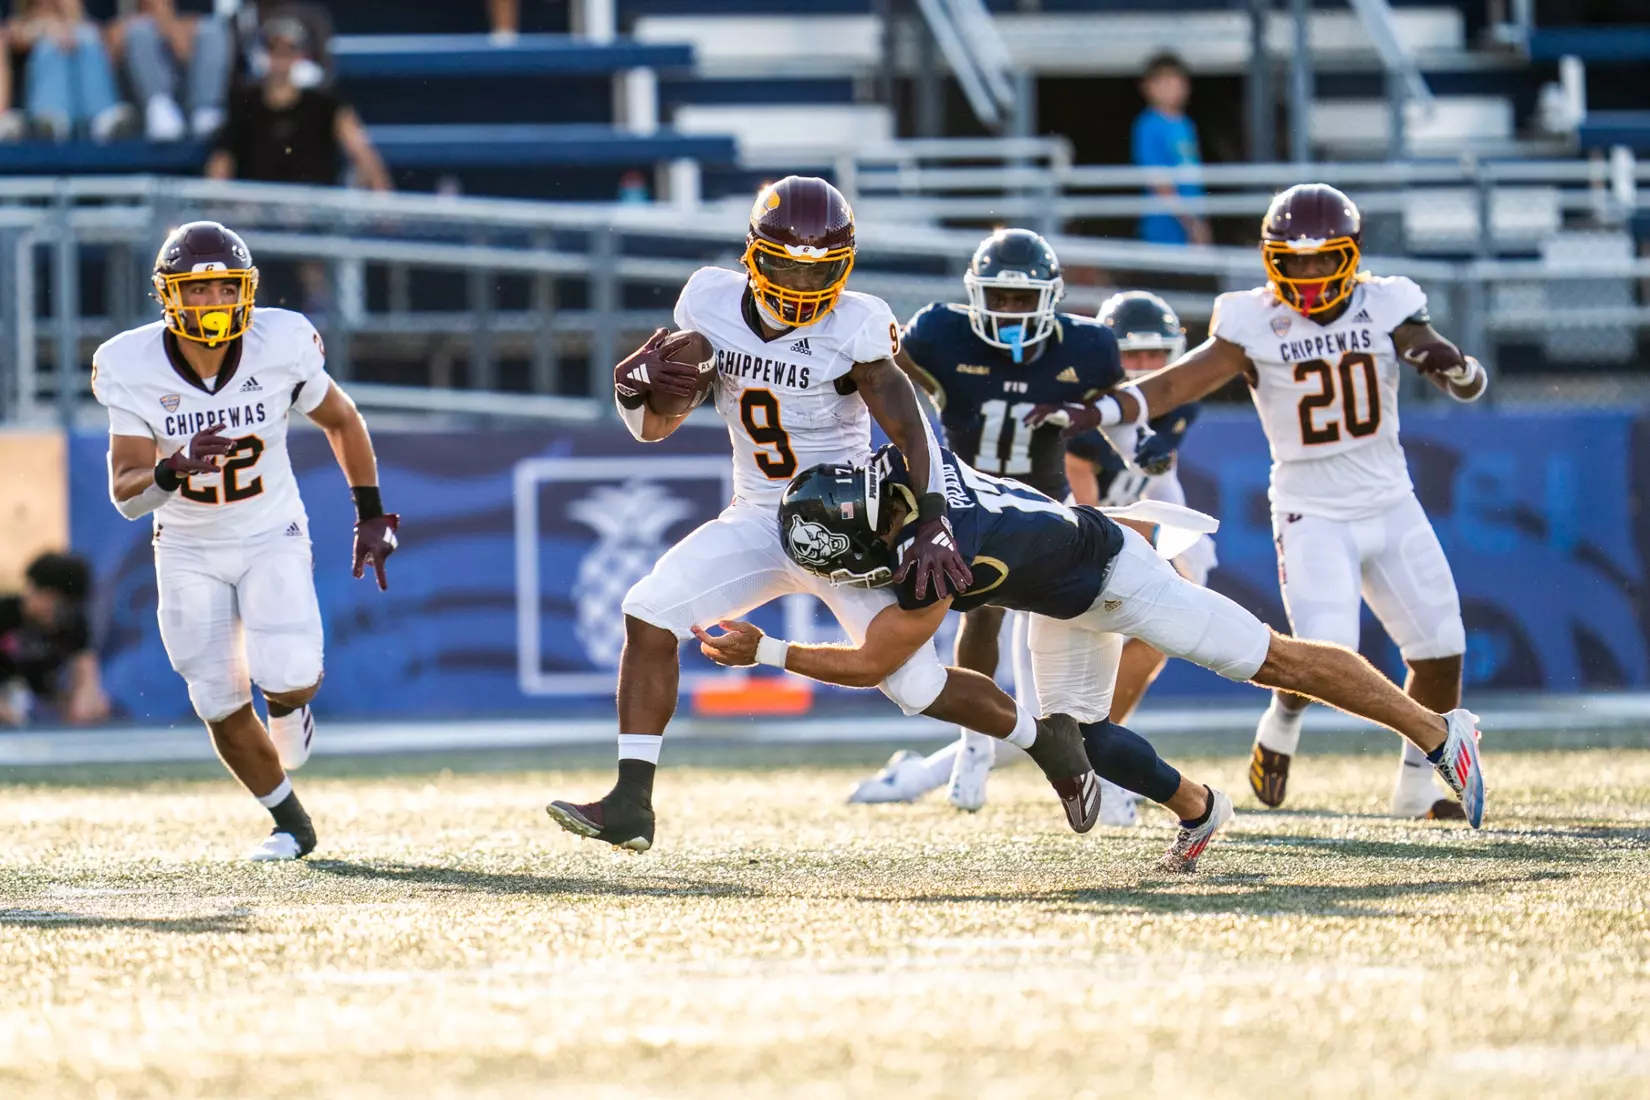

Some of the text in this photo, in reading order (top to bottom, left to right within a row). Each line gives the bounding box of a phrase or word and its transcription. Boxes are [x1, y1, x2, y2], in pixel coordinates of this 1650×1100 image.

[790, 345, 812, 356] adidas
[888, 321, 900, 356] 9
[1279, 329, 1371, 362] CHIPPEWAS
[718, 349, 810, 389] CHIPPEWAS
[1292, 350, 1381, 446] 20
[165, 402, 266, 436] CHIPPEWAS
[739, 388, 799, 480] 9
[974, 399, 1035, 474] 11
[835, 467, 853, 484] 17
